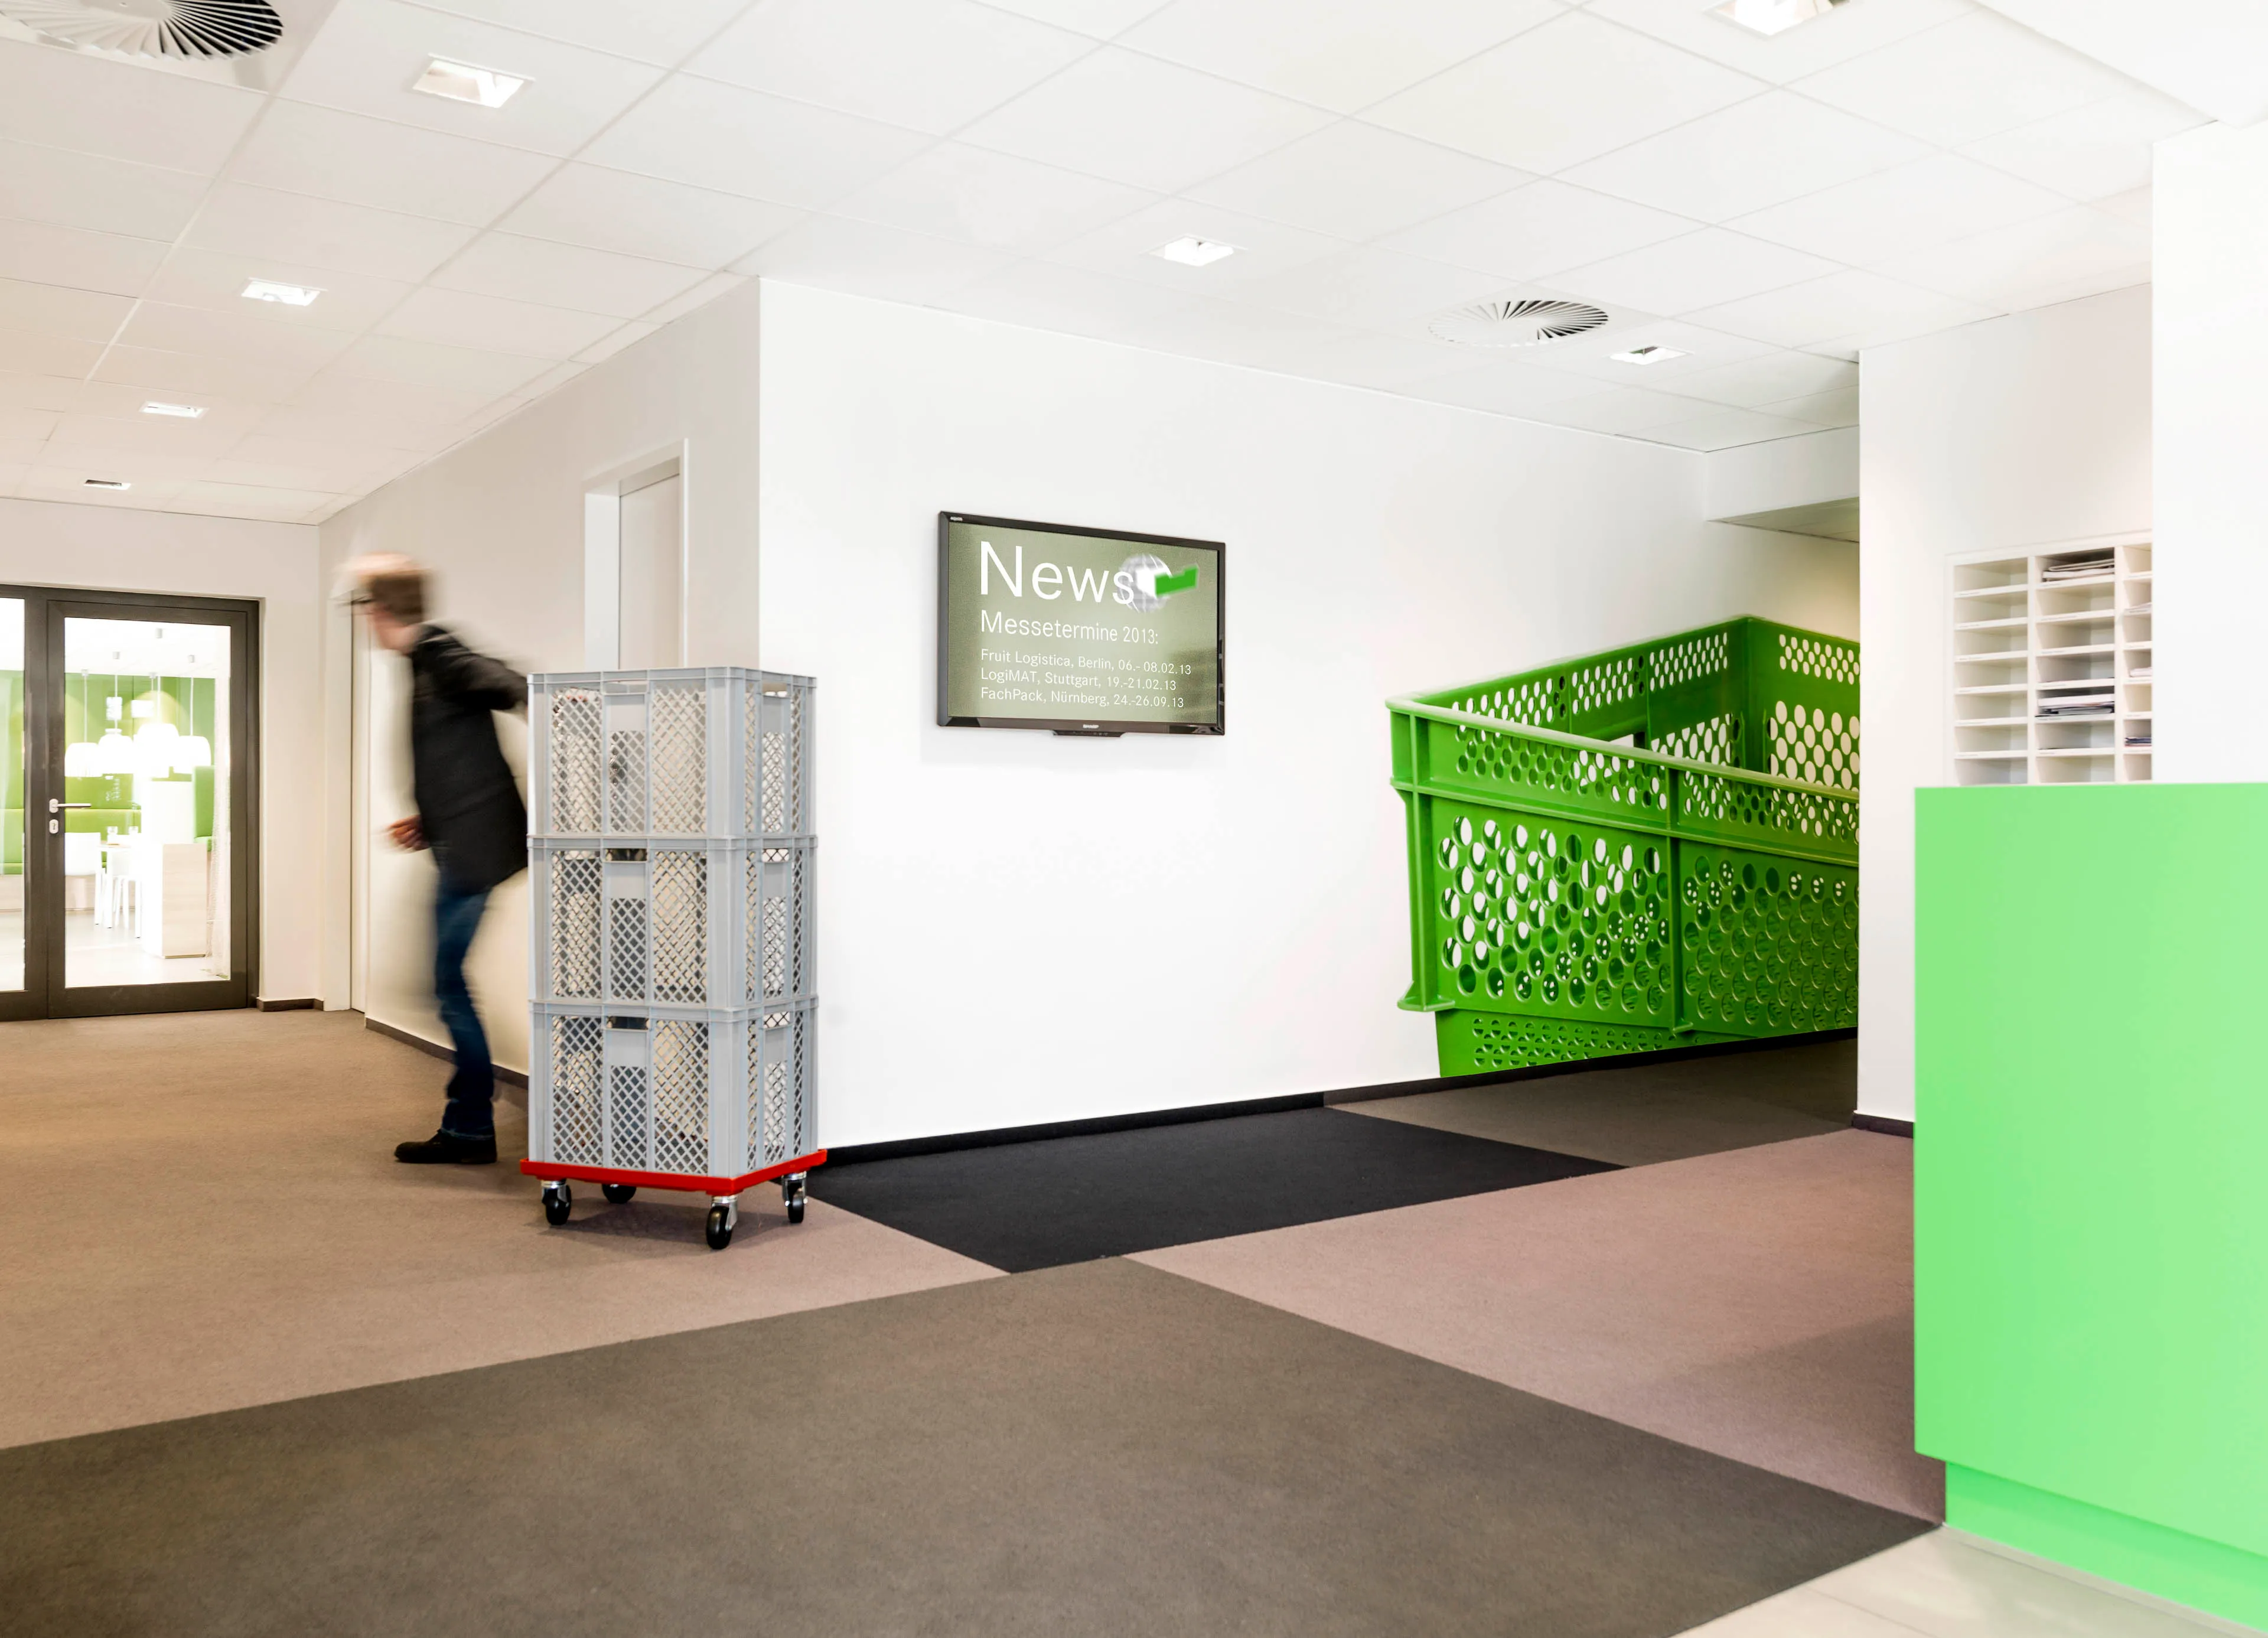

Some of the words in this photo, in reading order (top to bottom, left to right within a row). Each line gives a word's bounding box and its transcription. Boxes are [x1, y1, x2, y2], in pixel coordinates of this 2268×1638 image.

[980, 541, 1134, 604] News
[980, 610, 1117, 641] Messetermine
[1123, 626, 1158, 644] 2013:
[981, 649, 1011, 662] Fruit
[1015, 651, 1074, 668] Logistica,
[1078, 656, 1114, 671] Berlin,
[981, 667, 1040, 685] LogiMAT,
[1045, 672, 1102, 688] Stuttgart,
[981, 687, 1047, 703] FachPack,
[1051, 691, 1110, 707] Nürnberg,
